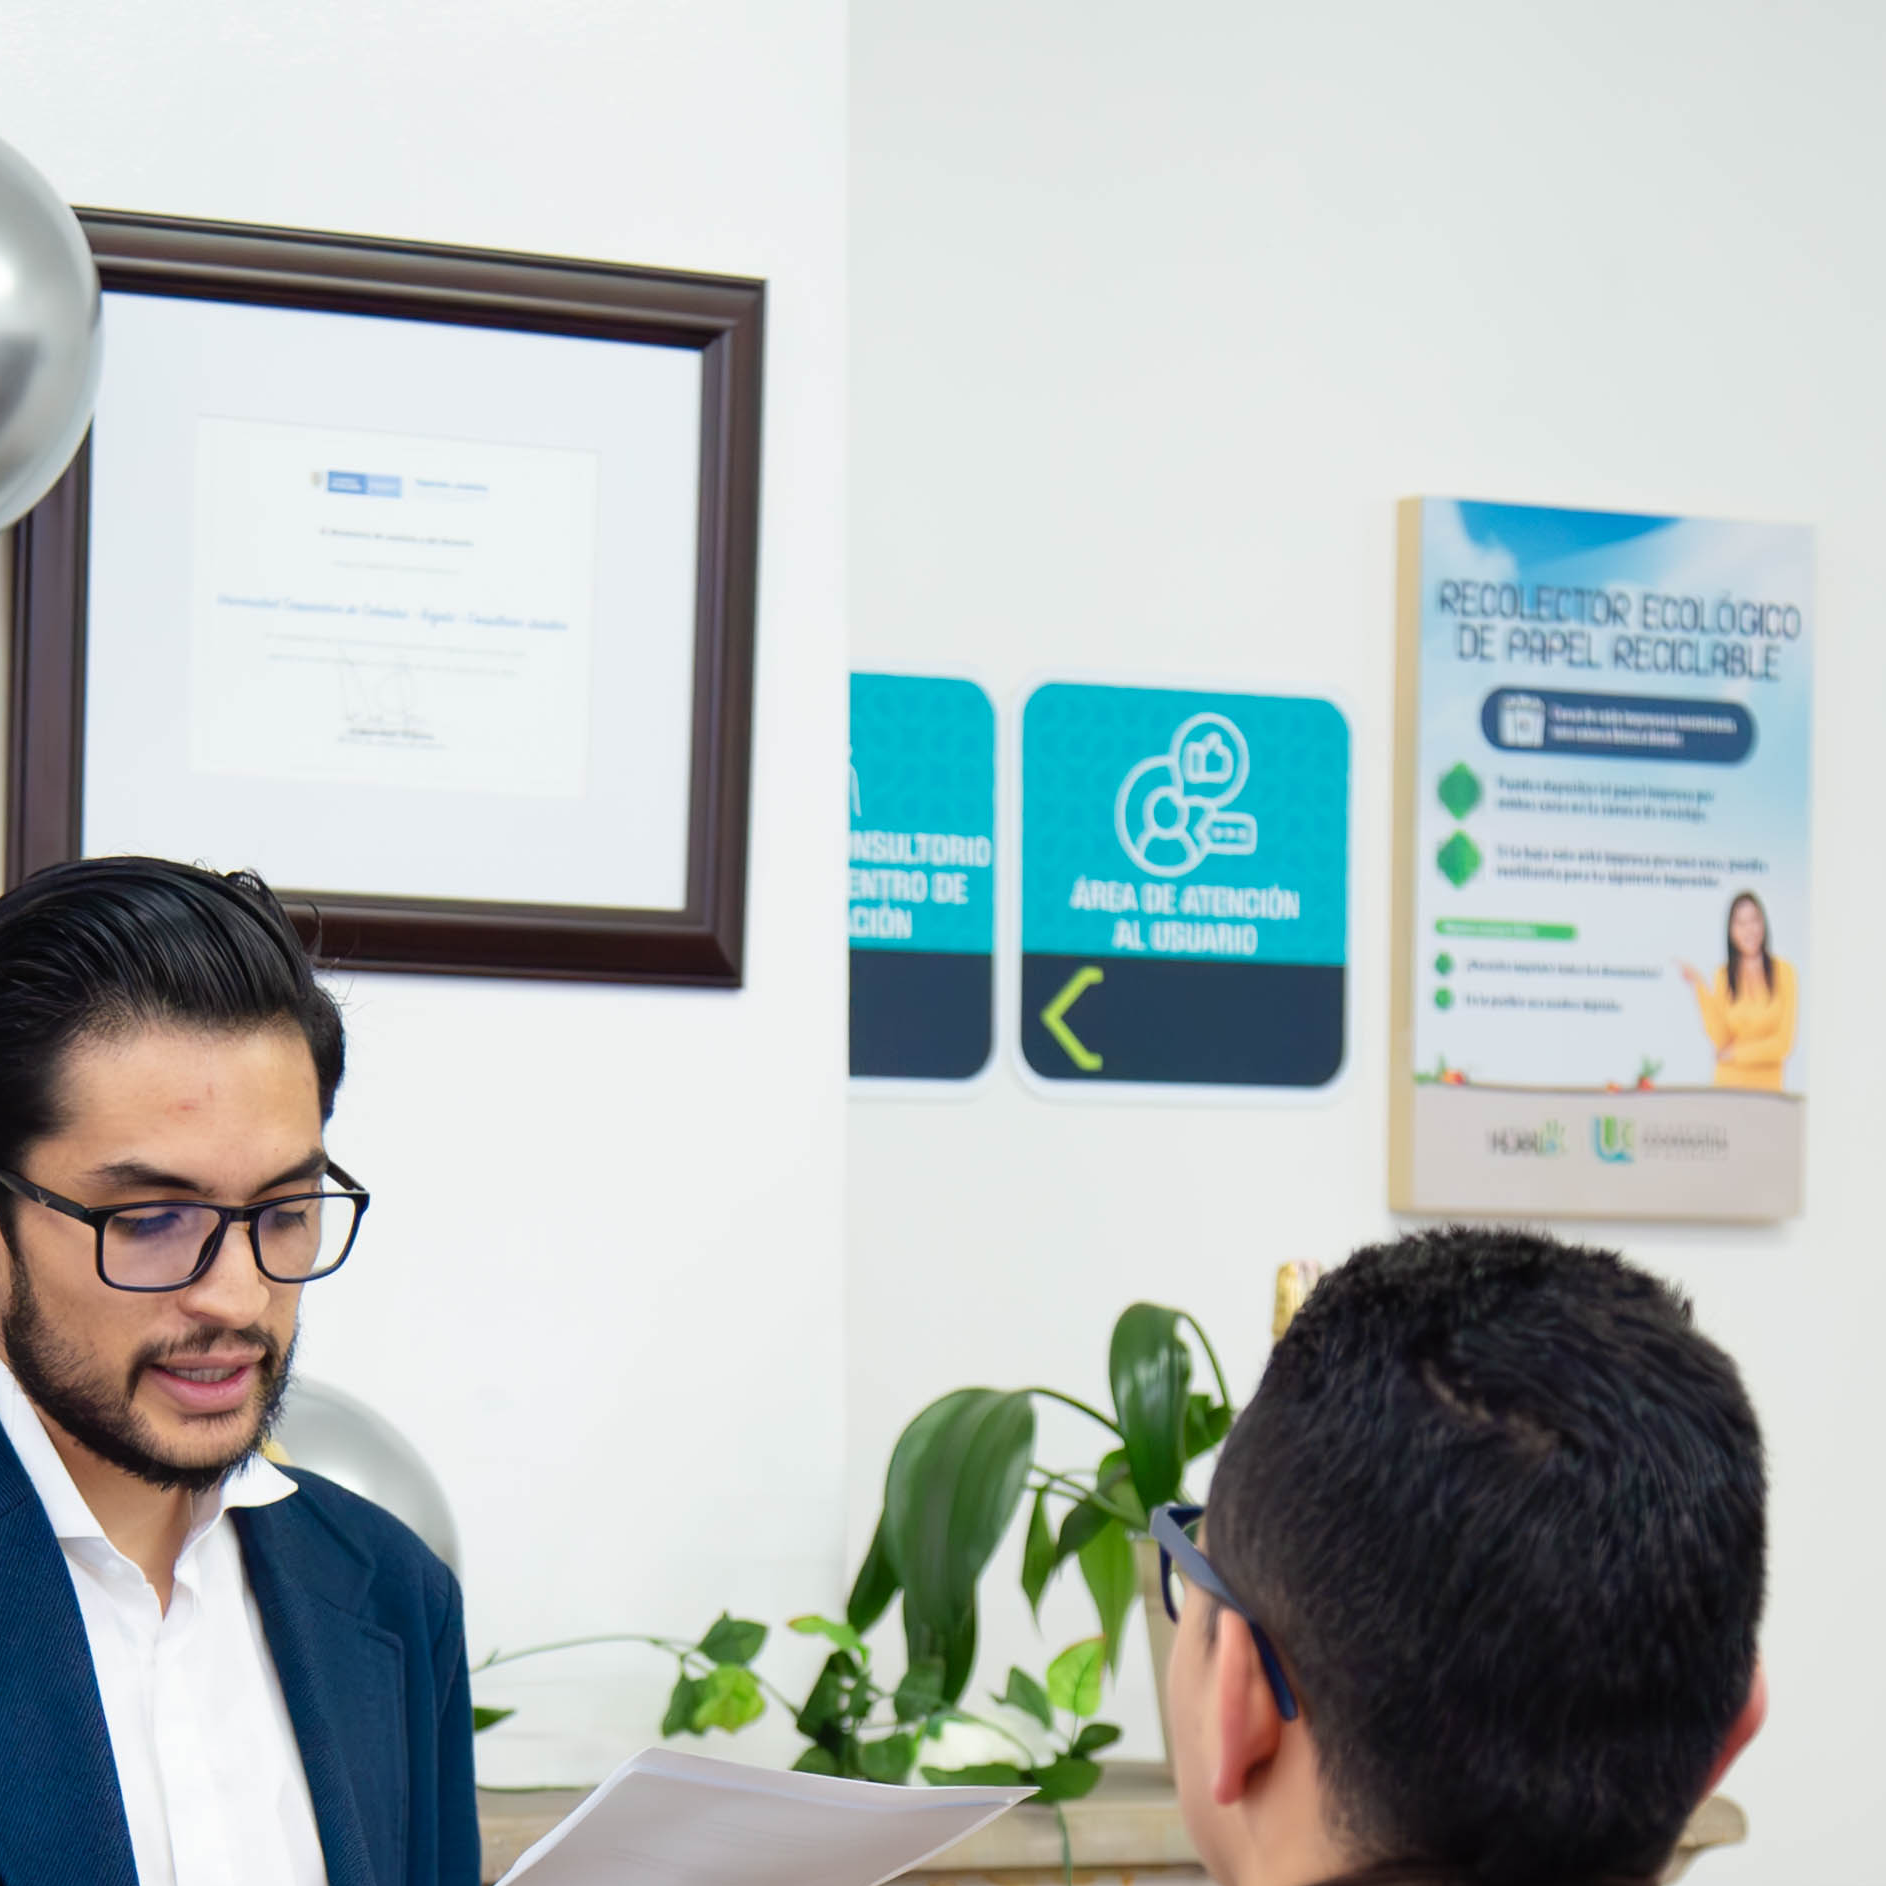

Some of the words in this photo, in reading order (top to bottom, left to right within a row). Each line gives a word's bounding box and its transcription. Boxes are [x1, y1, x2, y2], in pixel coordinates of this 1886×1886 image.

[1439, 580, 1631, 627] RECOLECTOR
[1642, 591, 1802, 642] ECOLÓGICO
[1457, 622, 1497, 662] DE
[1508, 627, 1601, 669] PAPEL
[1613, 634, 1780, 682] RECICLABLE
[930, 871, 970, 905] DE
[1069, 873, 1139, 913] ÁREA
[1140, 882, 1177, 915] DE
[1178, 883, 1300, 920] ATENCIÓN
[1111, 918, 1147, 951] AL
[1149, 920, 1258, 956] USUARIO
